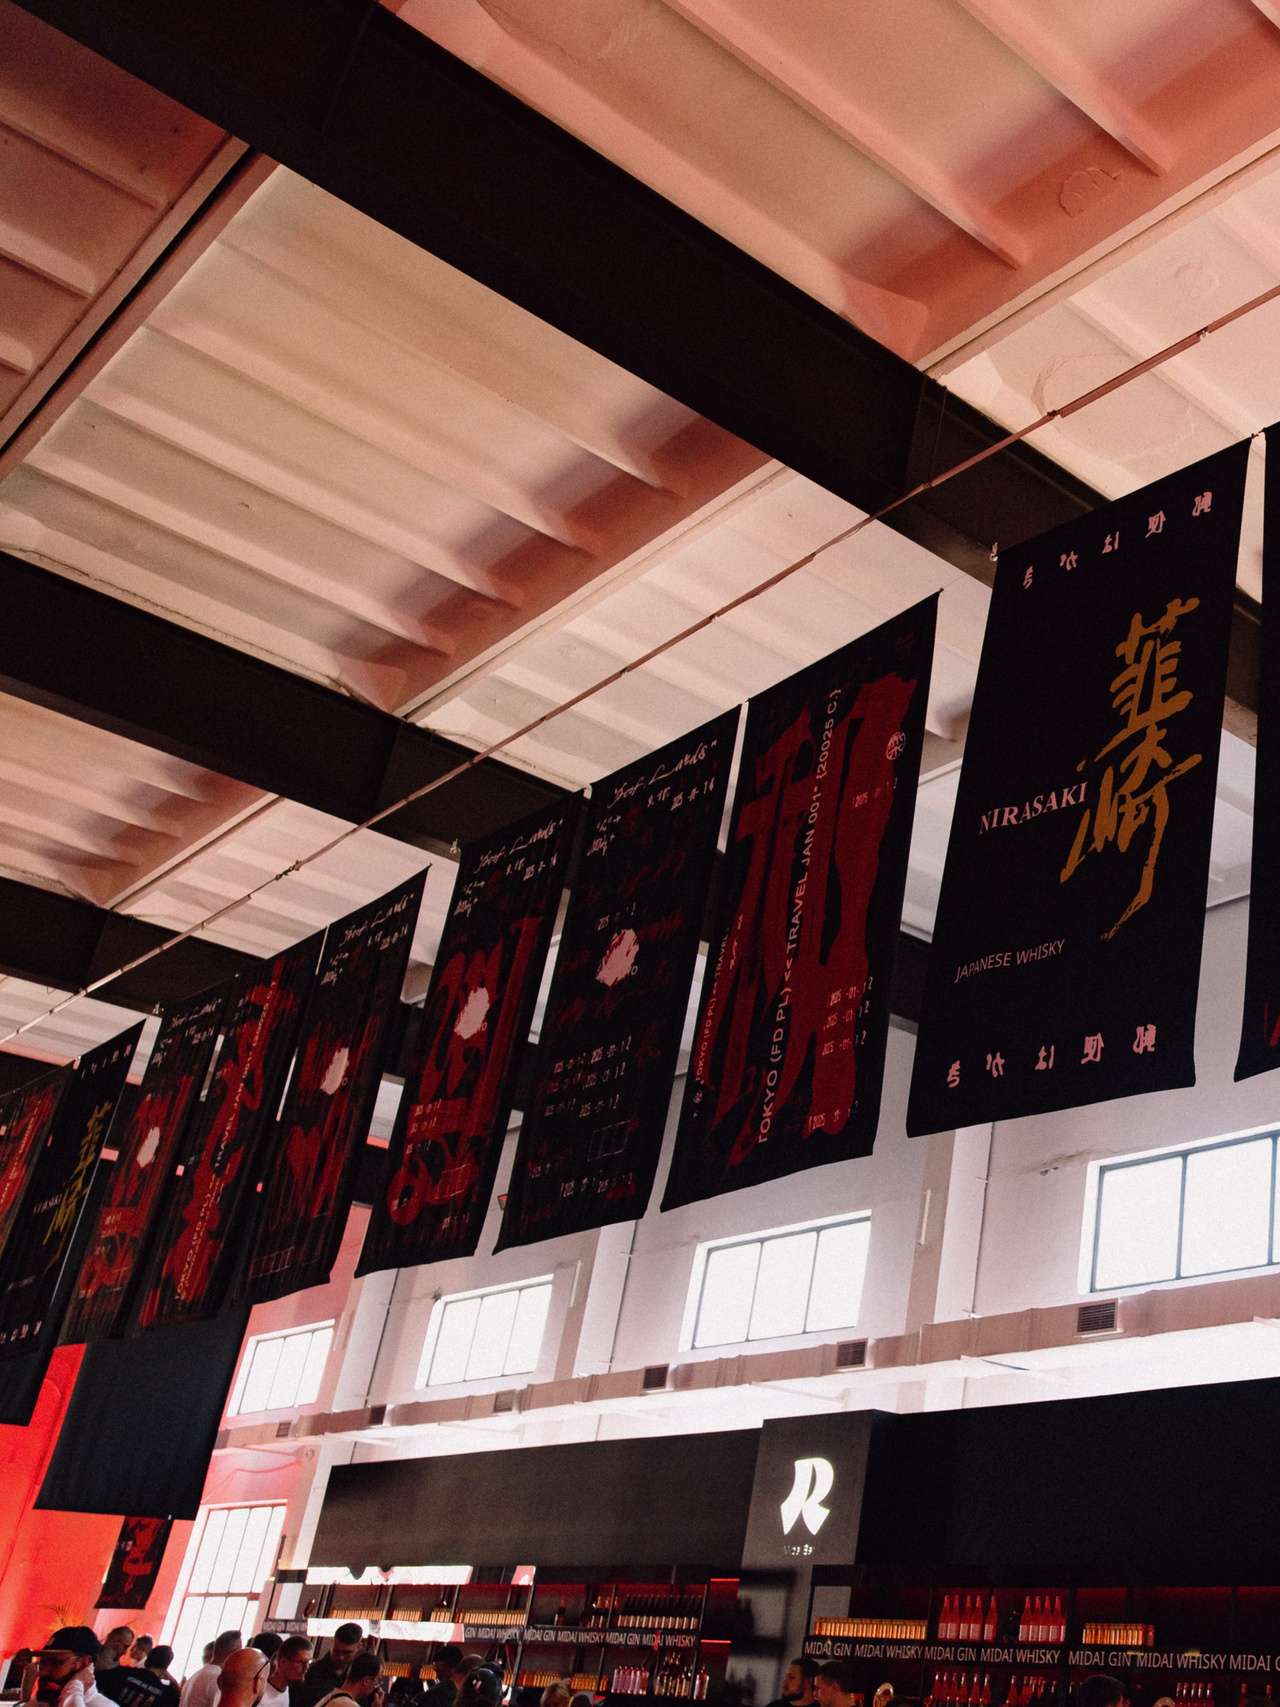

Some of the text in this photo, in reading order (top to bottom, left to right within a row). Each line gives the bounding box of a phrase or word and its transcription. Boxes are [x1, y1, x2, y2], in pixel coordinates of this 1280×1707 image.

[978, 781, 1088, 836] NIRASAKI
[953, 938, 1066, 984] JAPANESE WHISKY
[757, 1068, 778, 1144] TOKYO
[787, 870, 808, 954] TRAVEL
[800, 828, 816, 868] JAN
[578, 1631, 605, 1644] WHISKY
[605, 1632, 627, 1645] MIDAI
[627, 1632, 642, 1646] GIN
[665, 1634, 696, 1647] WHISKY
[804, 1640, 832, 1656] MIDAI
[833, 1643, 852, 1657] GIN
[855, 1644, 884, 1658] MIDAI
[886, 1645, 924, 1660] WHISKY
[924, 1646, 955, 1661] MIDAI
[956, 1647, 976, 1662] GIN
[980, 1647, 1014, 1663] MIDAI
[1015, 1648, 1061, 1665] WHISKY
[1068, 1651, 1105, 1666] MIDAI
[1107, 1652, 1131, 1668] GIN
[1136, 1653, 1174, 1670] MIDAI
[1176, 1653, 1228, 1671] WHISKY
[1229, 1654, 1272, 1672] MIDAI
